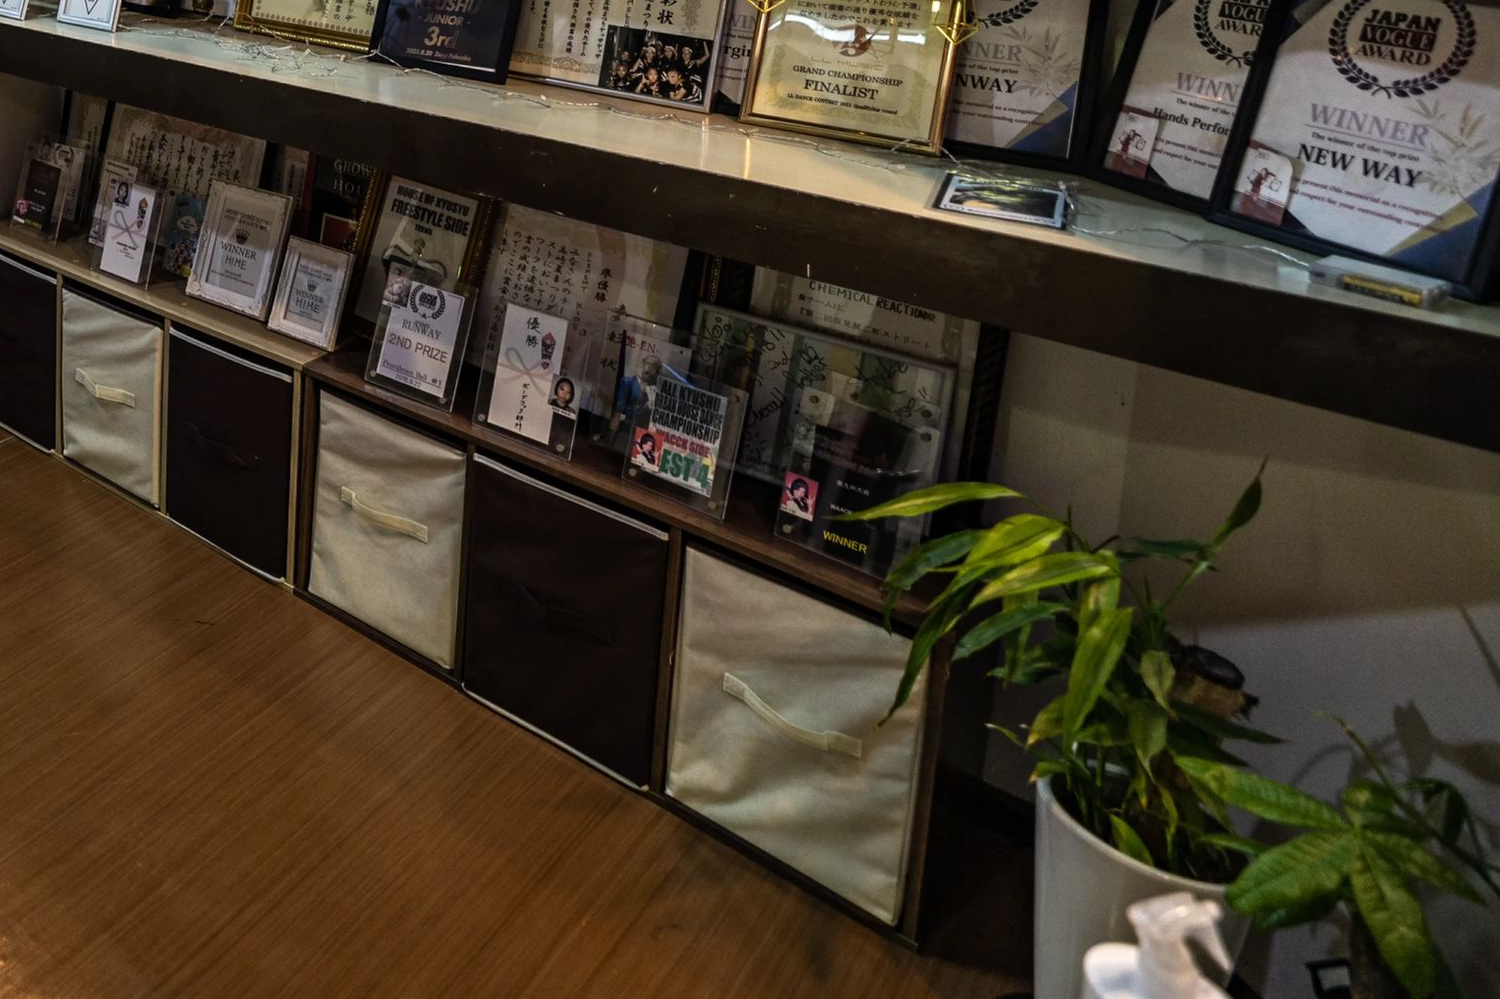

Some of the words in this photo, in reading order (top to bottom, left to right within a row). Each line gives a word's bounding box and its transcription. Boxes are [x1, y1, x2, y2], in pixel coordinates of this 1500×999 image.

[424, 13, 465, 26] JUNIOR
[1364, 8, 1442, 32] JAPAN
[1360, 23, 1436, 52] VOGUE
[1355, 42, 1431, 67] AWARD
[793, 65, 826, 76] GRAND
[827, 69, 903, 87] CHAMPIONSHIP
[804, 78, 879, 101] FINALIST
[1153, 106, 1189, 128] Hands
[1310, 102, 1429, 147] WINNER
[1298, 143, 1354, 173] NEW
[1360, 156, 1424, 191] WAY
[397, 185, 424, 203] HOUSE
[391, 198, 442, 228] FREESTYLE
[444, 215, 471, 237] SIDE
[221, 241, 257, 261] WINNER
[225, 255, 248, 271] HIME
[295, 288, 325, 304] WINNER
[809, 280, 873, 306] CHEMICAL
[295, 298, 321, 314] HIME
[402, 319, 442, 341] RUNWAY
[388, 333, 413, 351] 2ND
[414, 342, 448, 364] PRIZE
[681, 385, 722, 413] KYUSHU
[651, 408, 721, 446] CHAMPIONSHIP
[823, 529, 869, 555] WINNER
